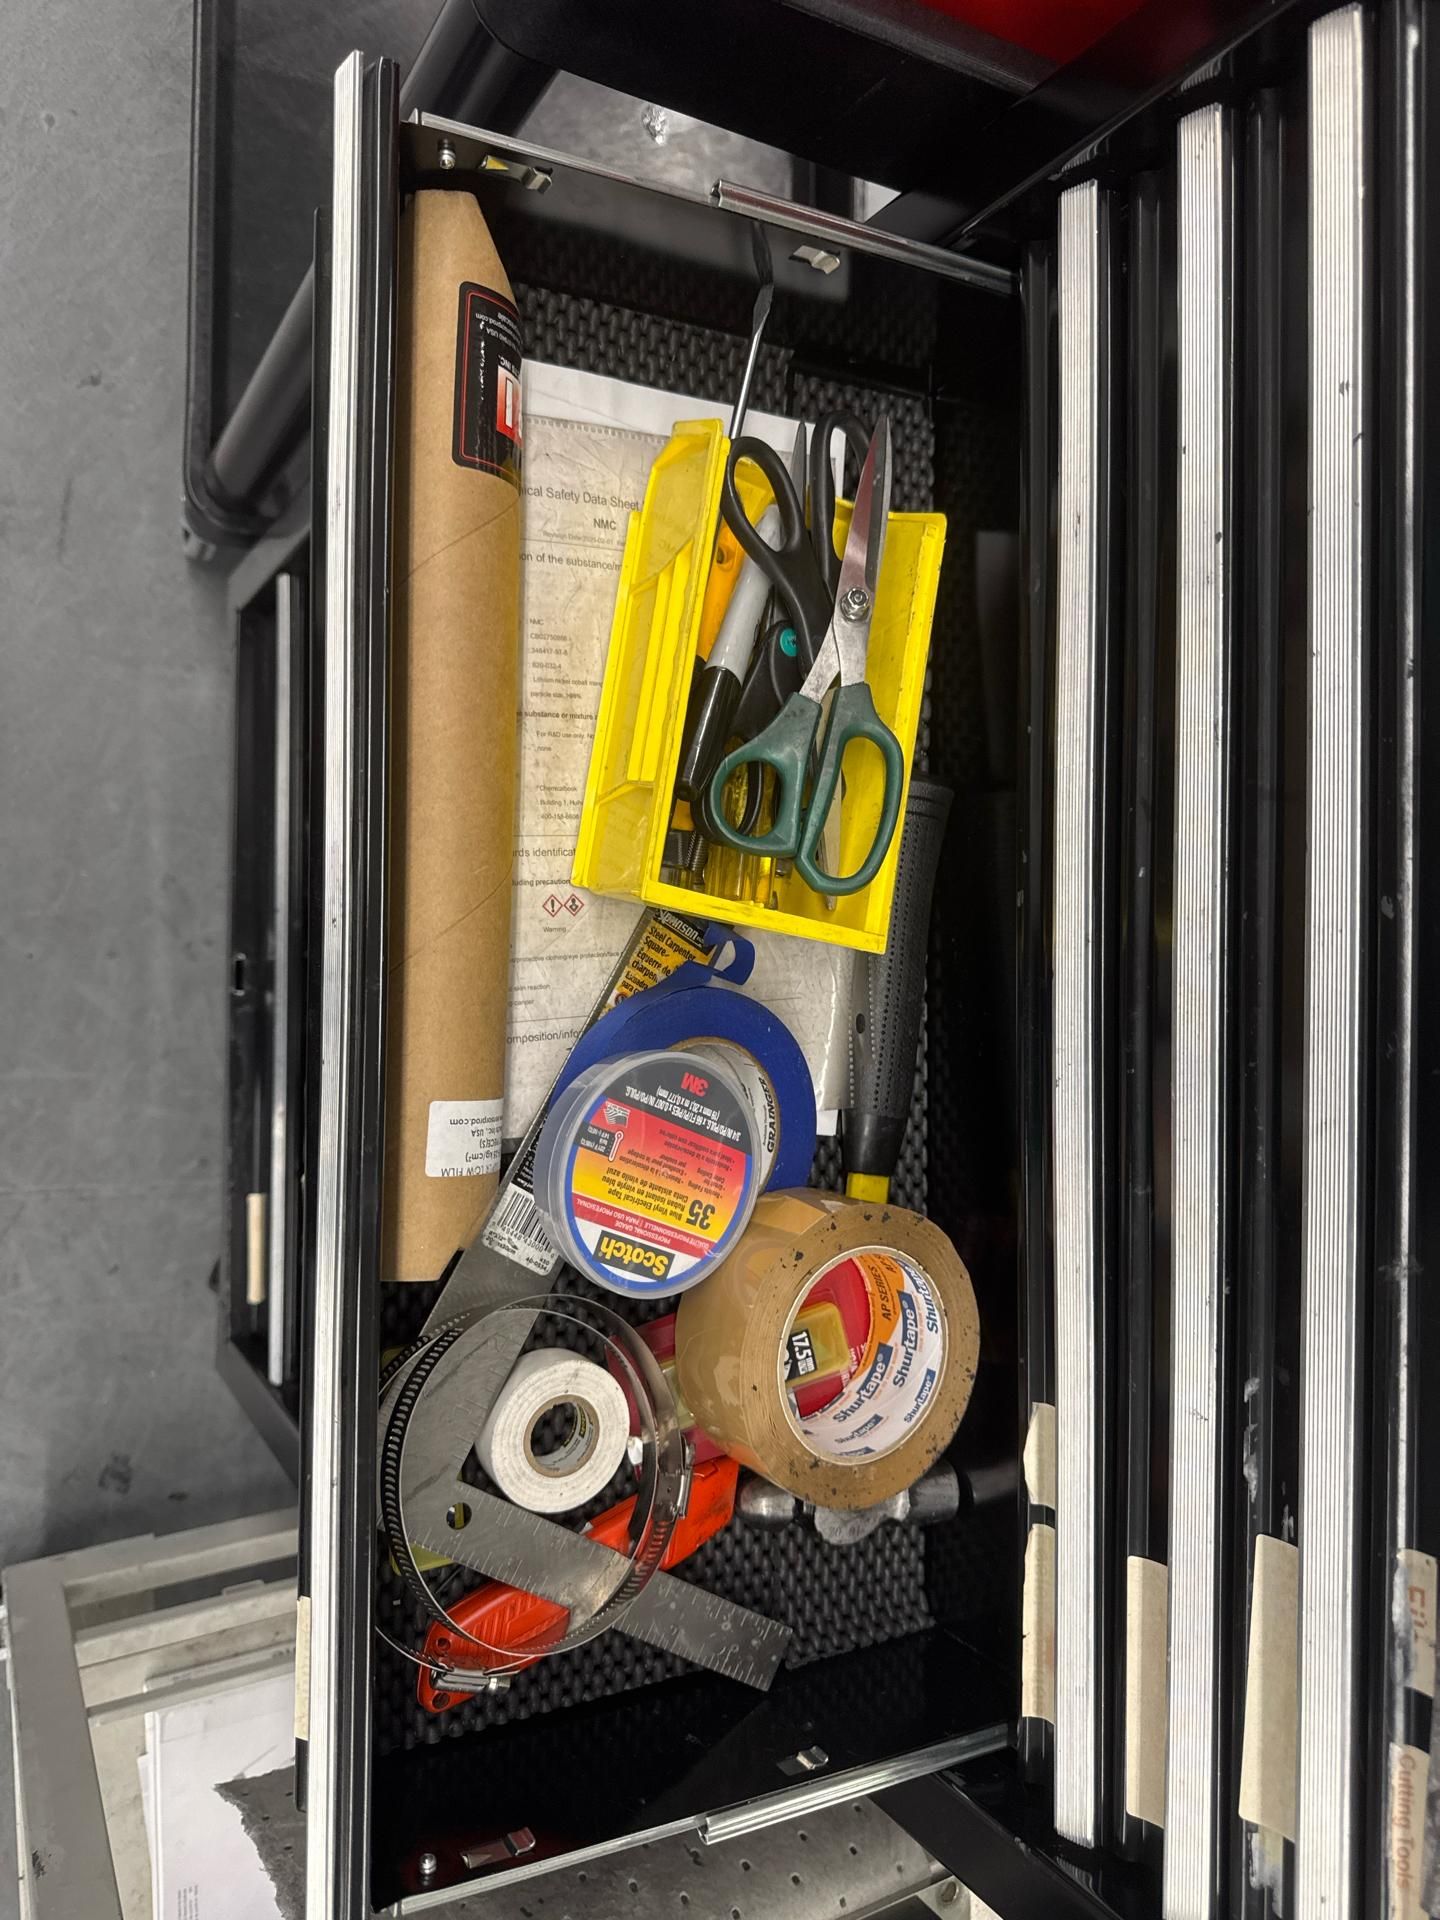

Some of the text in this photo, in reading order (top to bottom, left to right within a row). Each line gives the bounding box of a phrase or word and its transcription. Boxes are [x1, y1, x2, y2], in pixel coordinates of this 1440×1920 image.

[546, 487, 580, 504] Safety
[583, 492, 607, 506] Data
[610, 496, 639, 510] Sheet
[594, 518, 616, 530] NMC
[536, 553, 546, 562] of
[548, 554, 563, 564] the
[524, 710, 559, 718] substance
[644, 936, 666, 957] Square
[648, 926, 696, 961] Steel Carpenter
[662, 965, 671, 976] de
[622, 980, 634, 993] para
[679, 1071, 709, 1097] 3M
[758, 1076, 777, 1153] GRAINGER
[471, 1129, 484, 1137] USA
[441, 1167, 463, 1176] FILM
[467, 1165, 484, 1175] LOW
[600, 1175, 685, 1212] Ruban isolant en vinyle bleu
[605, 1166, 688, 1203] Cinta aislante de vinilo azul
[575, 1198, 613, 1216] PROFESIONAL
[606, 1187, 682, 1220] Blue Vinyl Electrical Tape
[612, 1210, 625, 1219] USO
[684, 1198, 716, 1231] 35
[614, 1219, 671, 1244] PROFESSIONAL GRADE
[624, 1214, 639, 1225] PARA
[597, 1236, 670, 1277] Scotch
[868, 1264, 891, 1320] AP SERIES
[791, 1331, 811, 1360] 17.5
[893, 1309, 918, 1387] Shurtape
[833, 1363, 886, 1422] Shurtape
[904, 1380, 932, 1422] Shurtape
[1394, 1754, 1416, 1890] Cutting Tools
